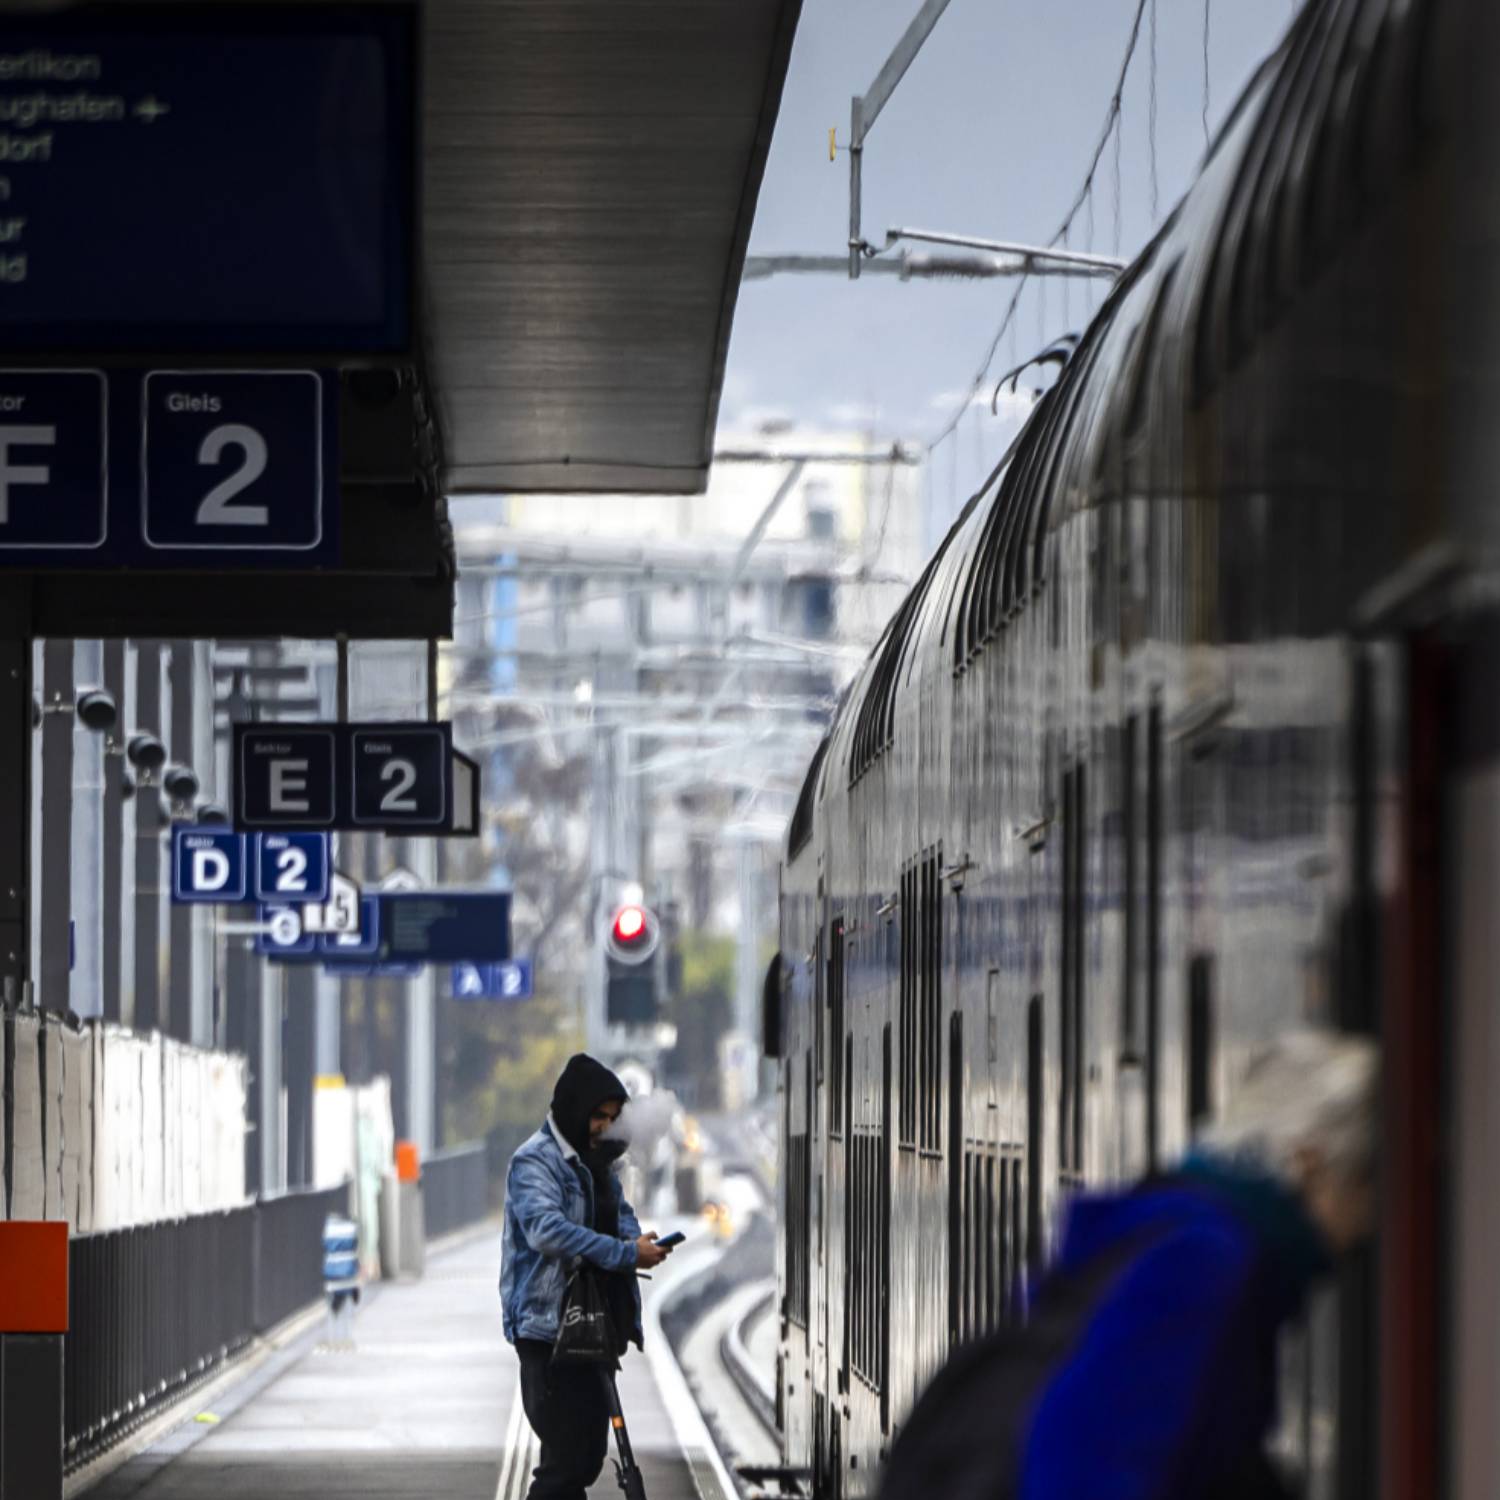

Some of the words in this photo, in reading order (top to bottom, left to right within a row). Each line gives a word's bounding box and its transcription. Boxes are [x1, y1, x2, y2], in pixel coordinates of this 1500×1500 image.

[167, 392, 222, 413] Gleis
[0, 424, 57, 525] F
[195, 423, 269, 525] 2
[269, 759, 310, 812] E
[380, 759, 417, 812] 2
[192, 848, 230, 891] D
[276, 848, 307, 891] 2
